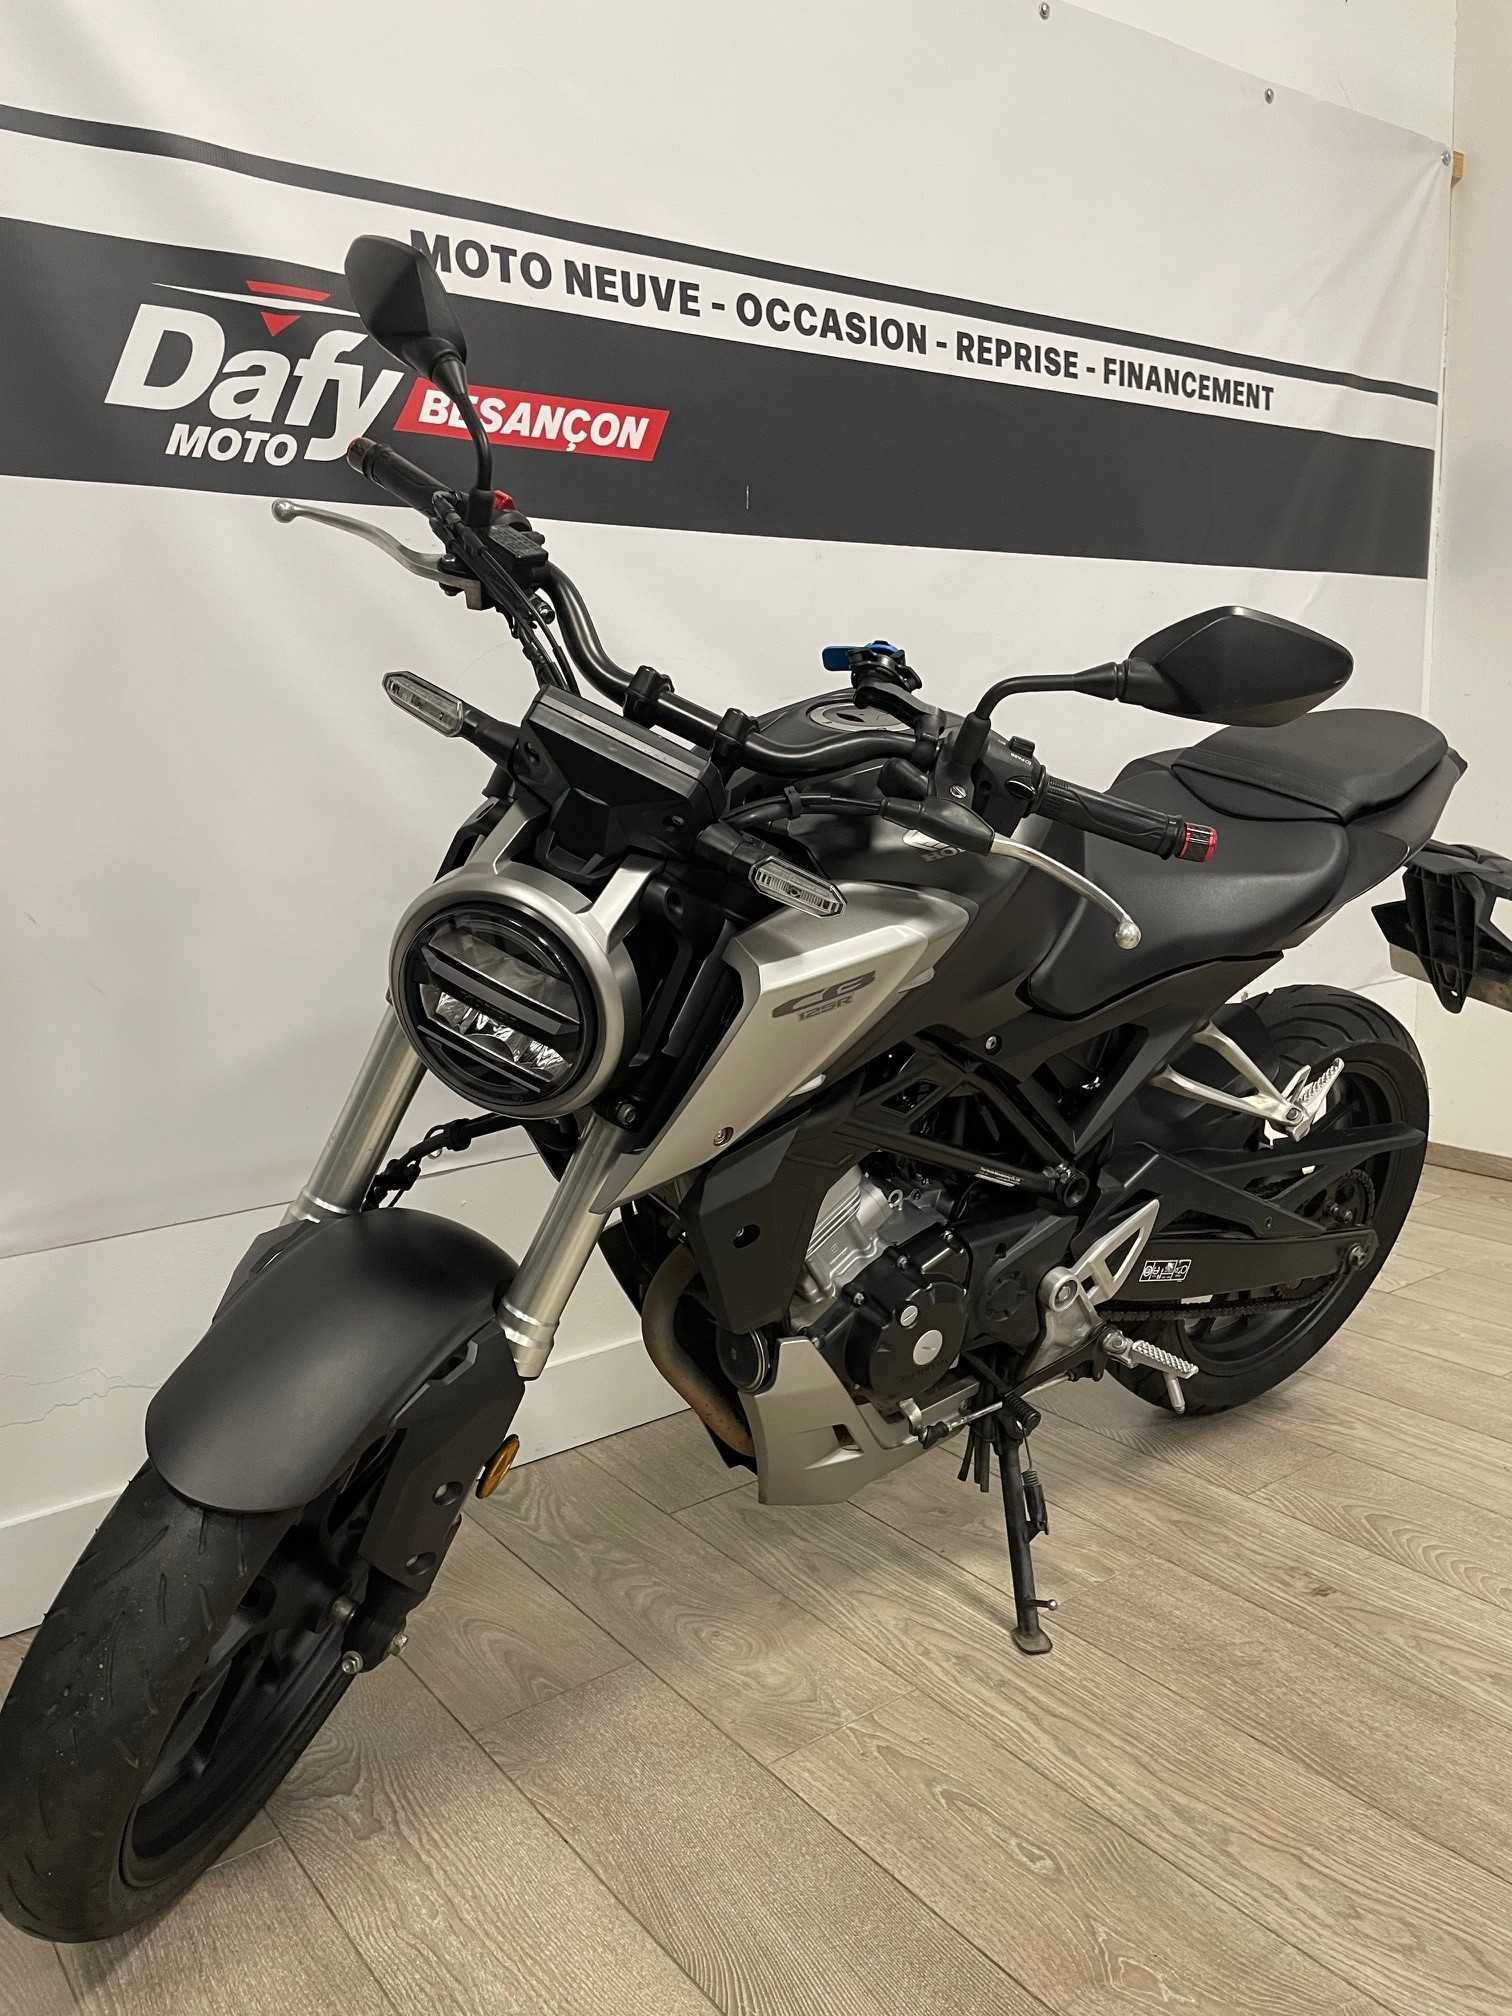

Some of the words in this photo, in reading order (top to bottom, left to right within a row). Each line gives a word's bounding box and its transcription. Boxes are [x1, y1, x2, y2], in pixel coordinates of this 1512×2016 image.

[410, 230, 552, 290] MOTO
[564, 259, 701, 318] NEUVE
[736, 292, 927, 355] OCCASION
[956, 330, 1079, 380] REPRISE
[1103, 357, 1274, 411] FINANCEMENT
[104, 303, 404, 462] Dafy
[418, 389, 650, 452] BESANÇON
[165, 423, 298, 467] MOTO
